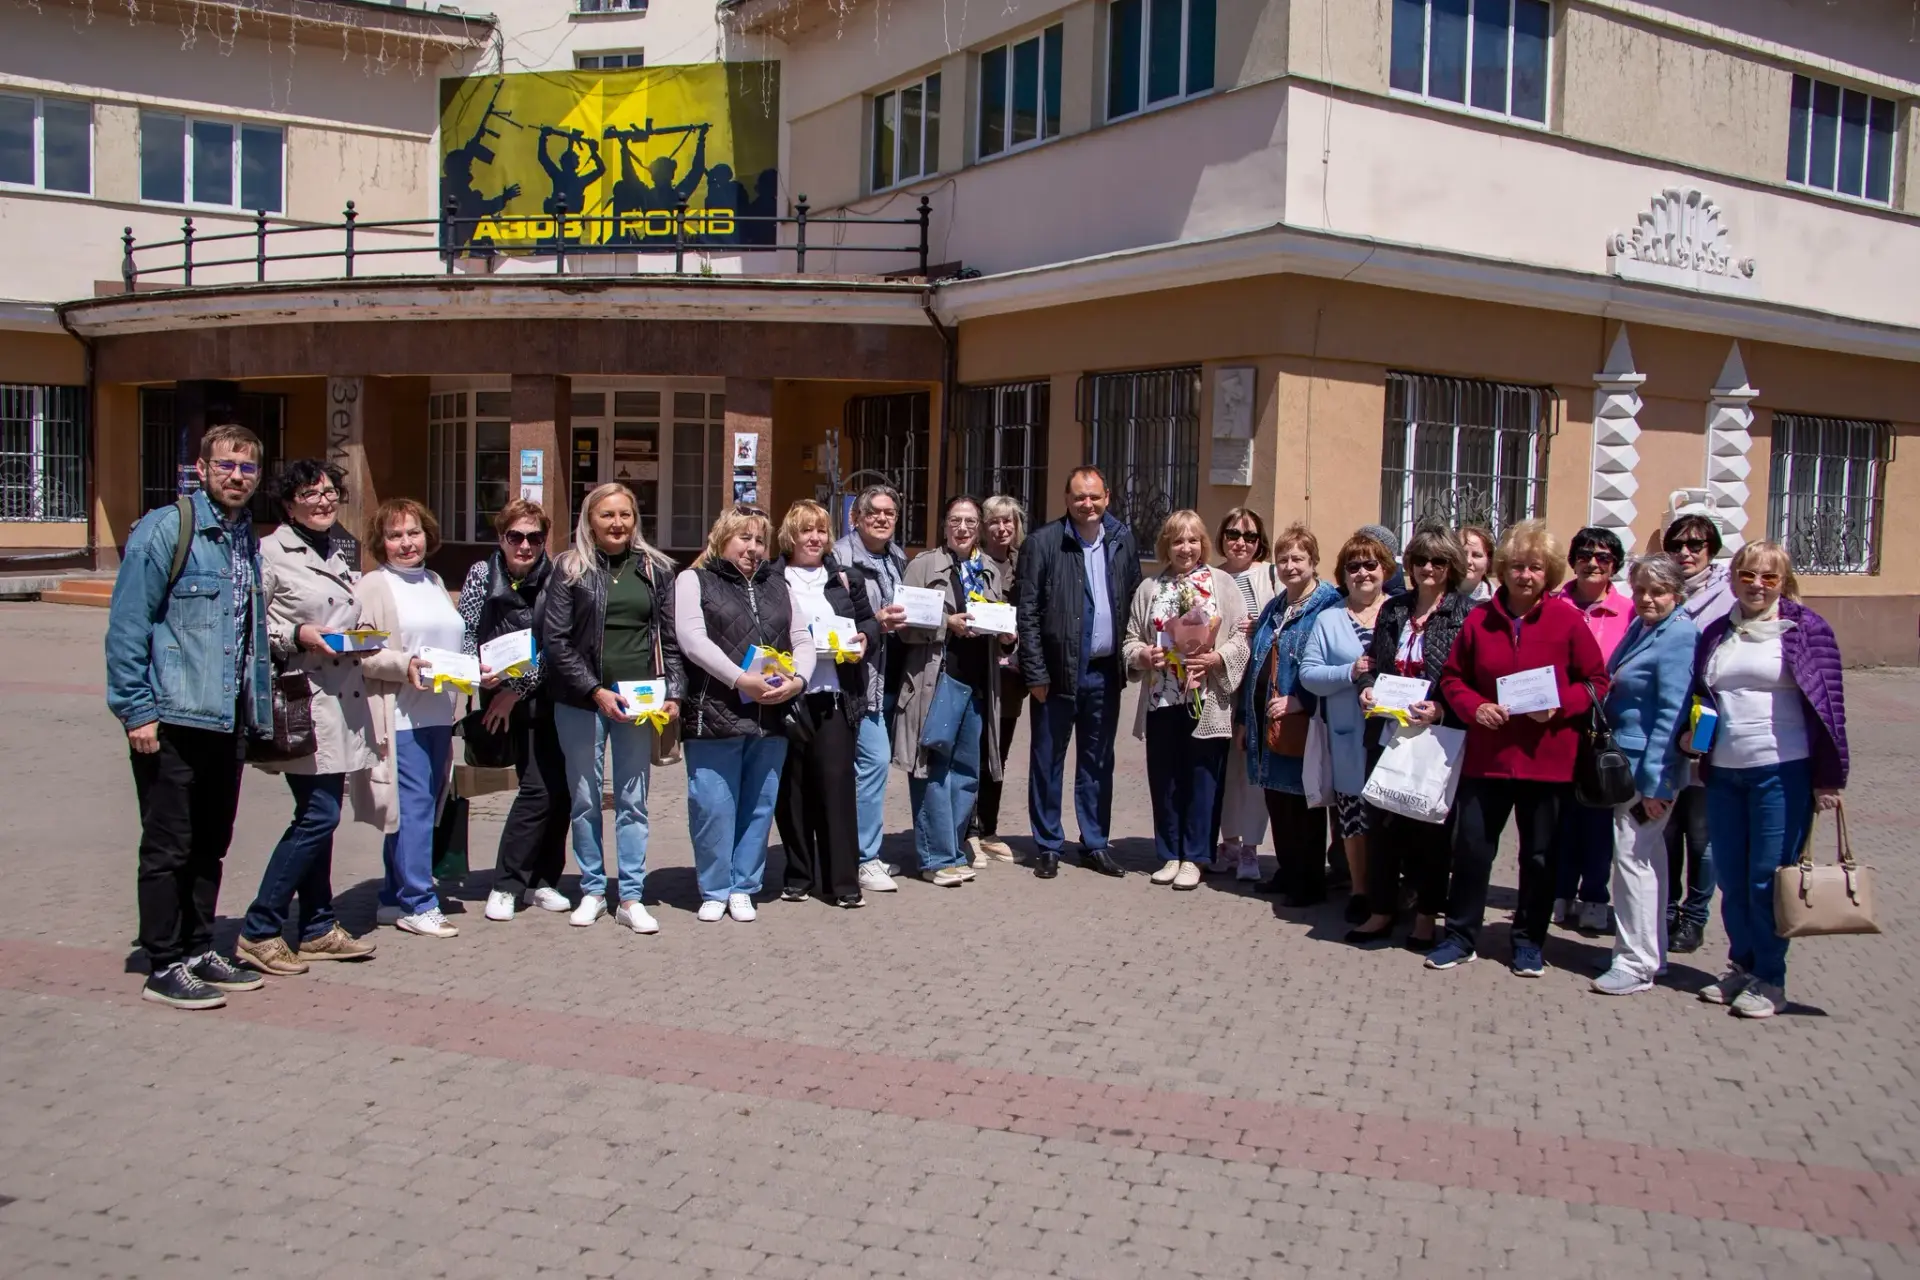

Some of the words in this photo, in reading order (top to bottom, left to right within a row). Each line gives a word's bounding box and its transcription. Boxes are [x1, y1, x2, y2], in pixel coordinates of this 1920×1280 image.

[472, 214, 582, 241] АЗОВ
[619, 208, 736, 239] РОКІВ
[1367, 783, 1427, 809] FASHIONISTA
